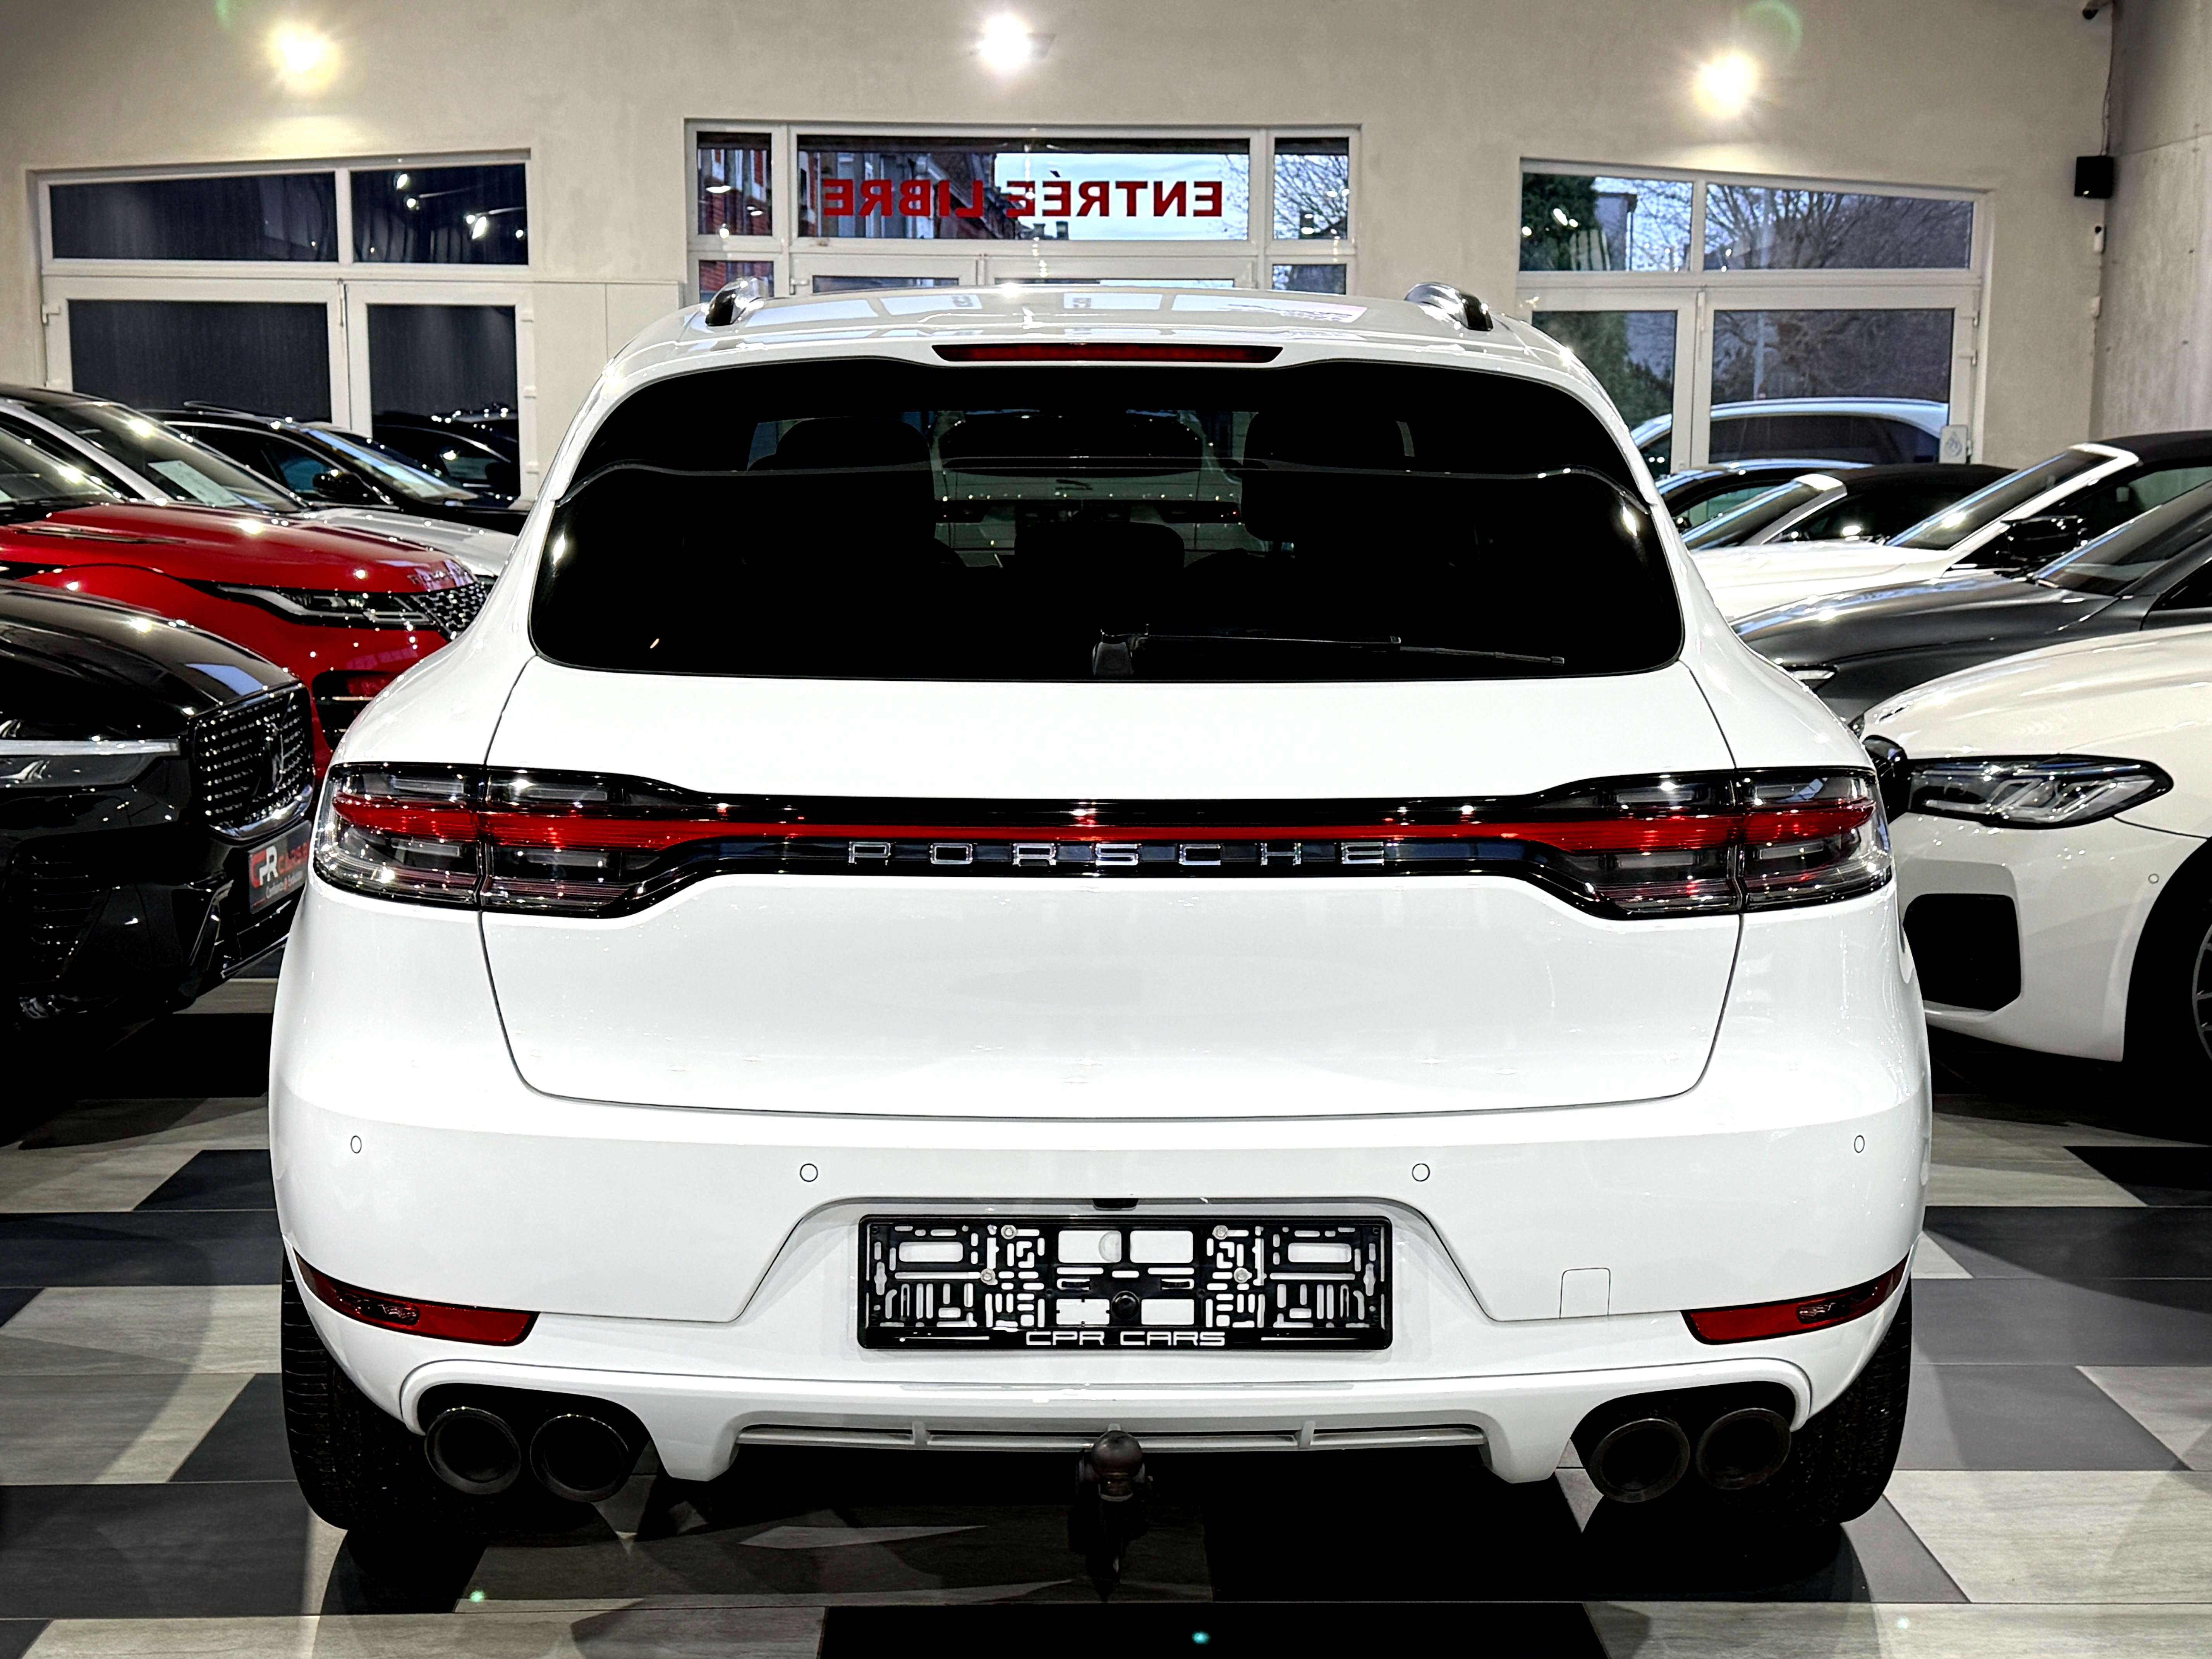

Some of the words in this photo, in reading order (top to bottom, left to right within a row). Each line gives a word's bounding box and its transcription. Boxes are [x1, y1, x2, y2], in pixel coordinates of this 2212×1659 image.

[848, 841, 1384, 867] PORSCHE
[1025, 1331, 1105, 1346] CPR
[1120, 1331, 1226, 1346] CARS
